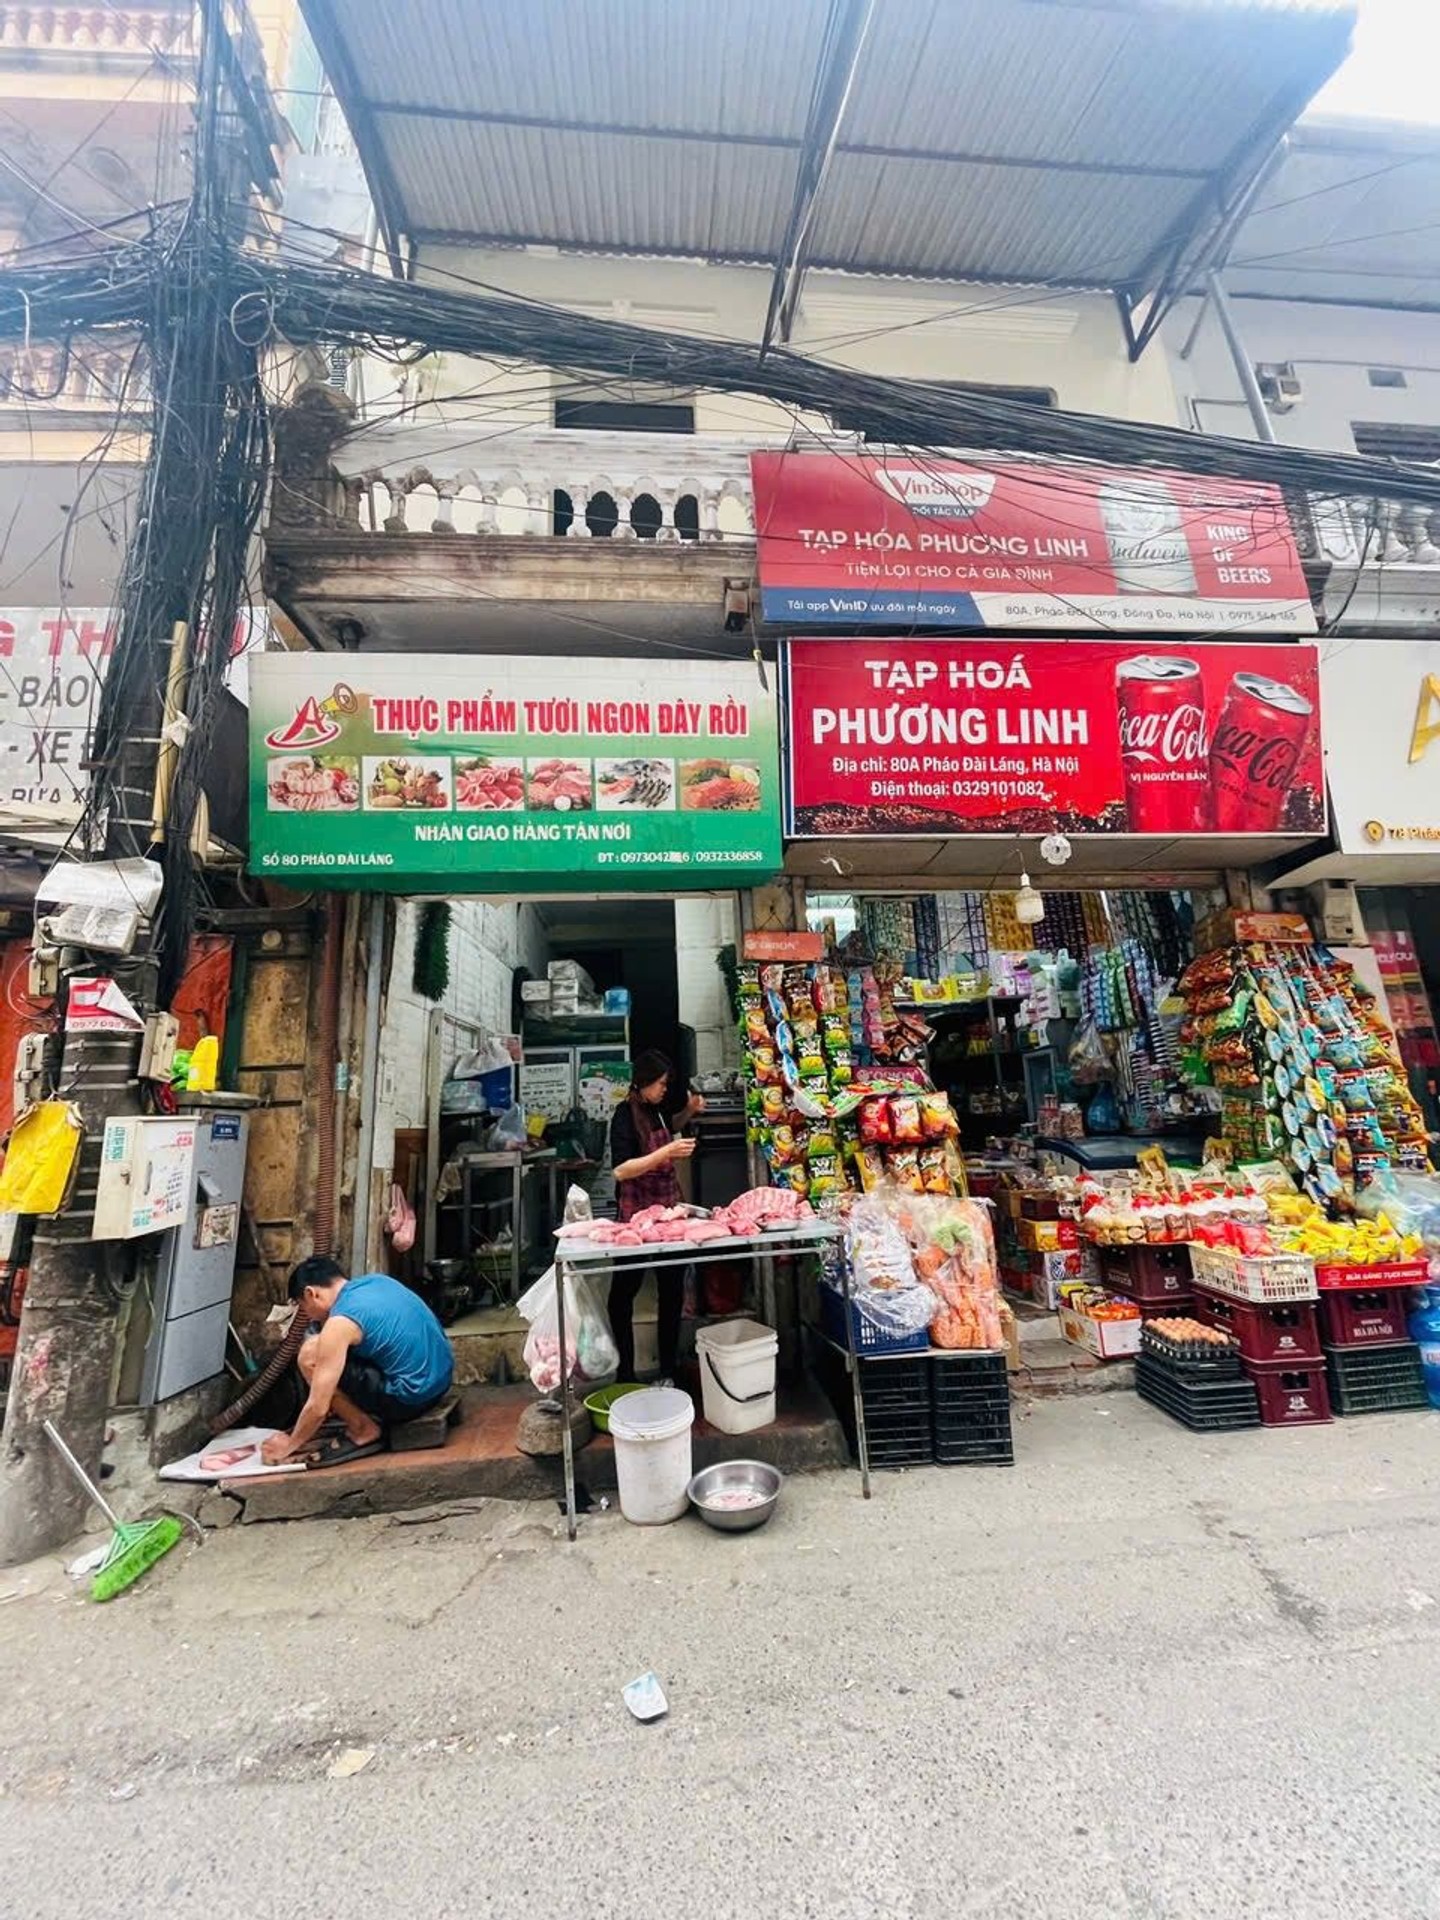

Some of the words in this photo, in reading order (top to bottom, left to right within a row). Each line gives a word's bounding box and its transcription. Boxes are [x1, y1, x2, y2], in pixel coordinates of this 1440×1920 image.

[891, 477, 984, 500] VinShop
[934, 507, 951, 516] TÁC
[799, 529, 847, 555] TẠP
[855, 528, 912, 551] HÓA
[920, 532, 1029, 557] PHƯƠNG
[1035, 537, 1088, 557] LINH
[1206, 525, 1249, 542] KING
[1213, 547, 1235, 562] OF
[846, 561, 879, 579] TIỆN
[884, 563, 911, 579] LỢI
[916, 565, 951, 578] CHO
[984, 566, 1010, 579] GIA
[1218, 567, 1272, 585] BEERS
[788, 599, 805, 610] Tải
[807, 602, 829, 613] app
[829, 597, 867, 612] VinID
[929, 603, 957, 616] ngày
[864, 661, 938, 694] TẠP
[949, 654, 1031, 690] HOÁ
[18, 667, 89, 707] BẢO
[373, 694, 439, 739] THỰC
[447, 688, 516, 732] PHẨM
[524, 696, 579, 733] TƯƠI
[588, 702, 650, 734] NGON
[658, 698, 702, 734] ĐÂY
[709, 694, 747, 735] RỒI
[812, 702, 987, 745] PHƯƠNG
[997, 708, 1089, 745] LINH
[1117, 704, 1209, 763] Coca-Col
[27, 731, 72, 764] XE
[833, 757, 858, 776] Địa
[860, 756, 887, 773] chỉ:
[890, 758, 920, 773] 80A
[923, 756, 960, 773] Pháo
[963, 756, 987, 773] Đài
[990, 756, 1030, 777] Láng,
[1032, 757, 1052, 773] Hà
[1056, 757, 1079, 776] Nội
[1143, 769, 1184, 782] NGUYÊN
[871, 780, 905, 799] Điện
[908, 780, 949, 799] thoại:
[952, 781, 1045, 797] 0329101082
[415, 824, 463, 845] NHẬN
[466, 826, 509, 841] GIAO
[514, 821, 560, 841] HÀNG
[563, 821, 600, 843] TẬN
[602, 822, 631, 841] NƠI
[282, 854, 299, 866] 80
[301, 852, 335, 866] PHÁO
[361, 853, 393, 866] LÁNG
[622, 851, 690, 863] 09730426
